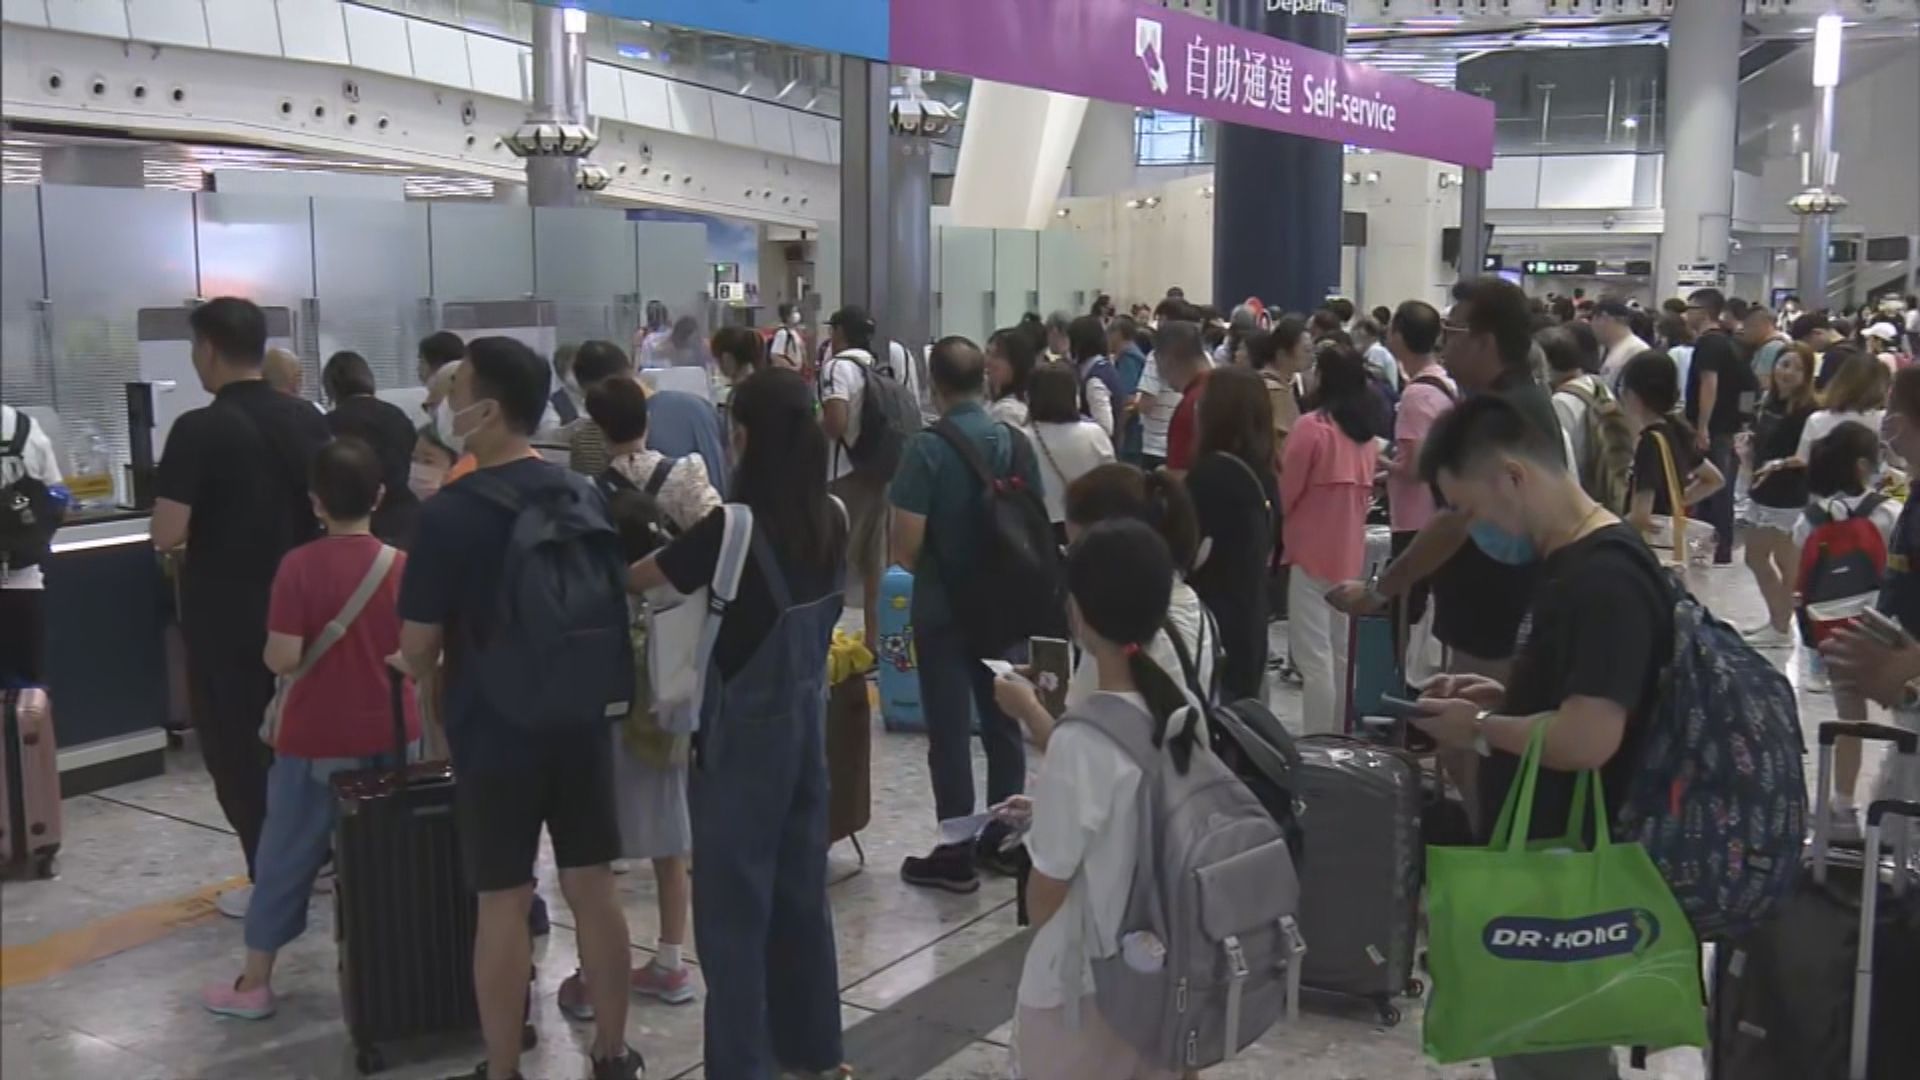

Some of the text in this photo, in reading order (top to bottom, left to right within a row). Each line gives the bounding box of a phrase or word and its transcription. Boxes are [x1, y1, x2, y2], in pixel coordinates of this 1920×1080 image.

[1185, 35, 1396, 132] 自助通道 Self-service
